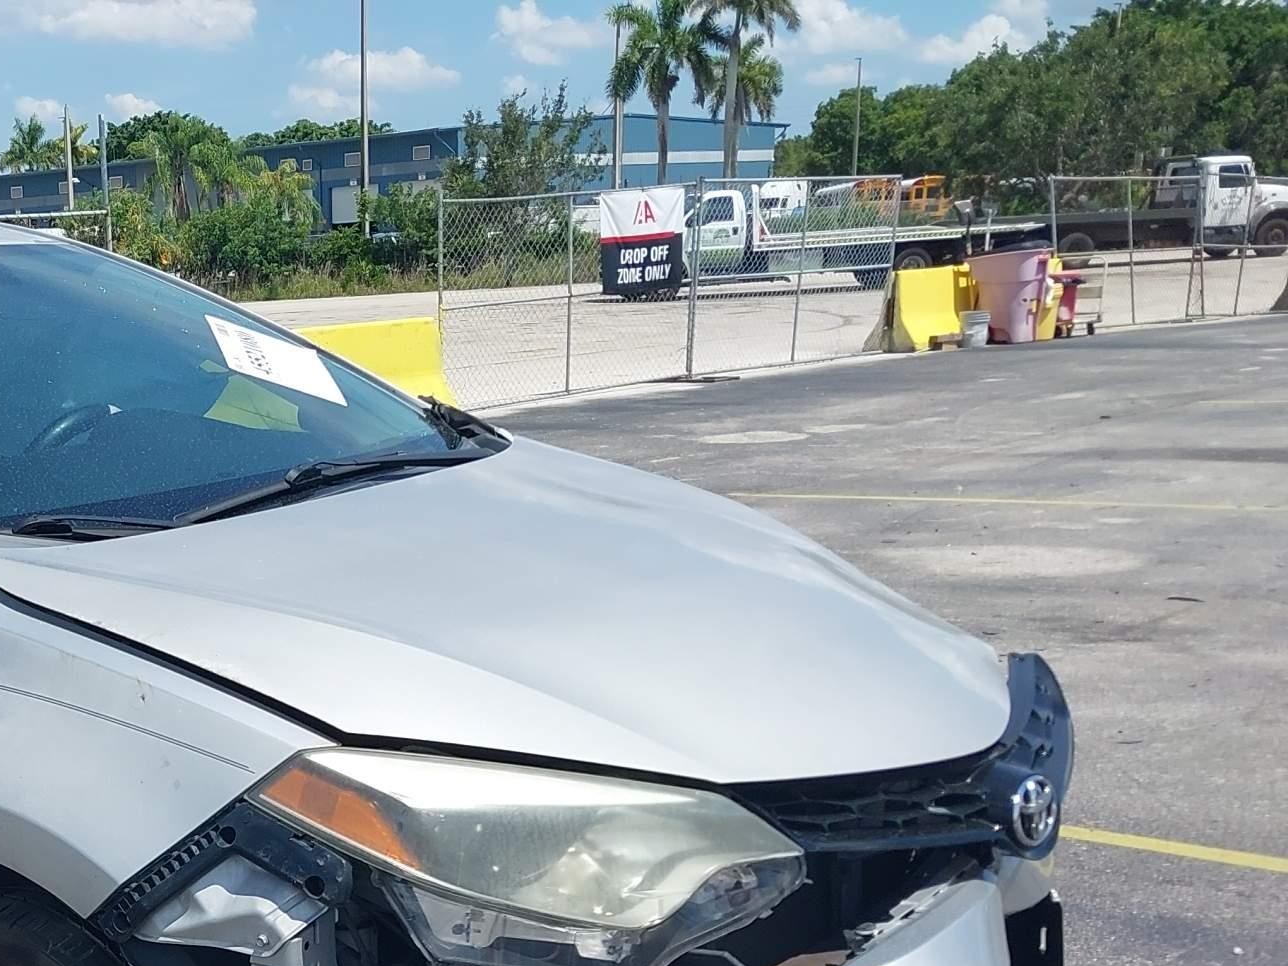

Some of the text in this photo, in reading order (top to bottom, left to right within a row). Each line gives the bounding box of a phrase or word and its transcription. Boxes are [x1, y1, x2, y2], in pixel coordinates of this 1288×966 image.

[620, 244, 669, 265] DROP OFF
[617, 264, 671, 284] ZONE ONLY
